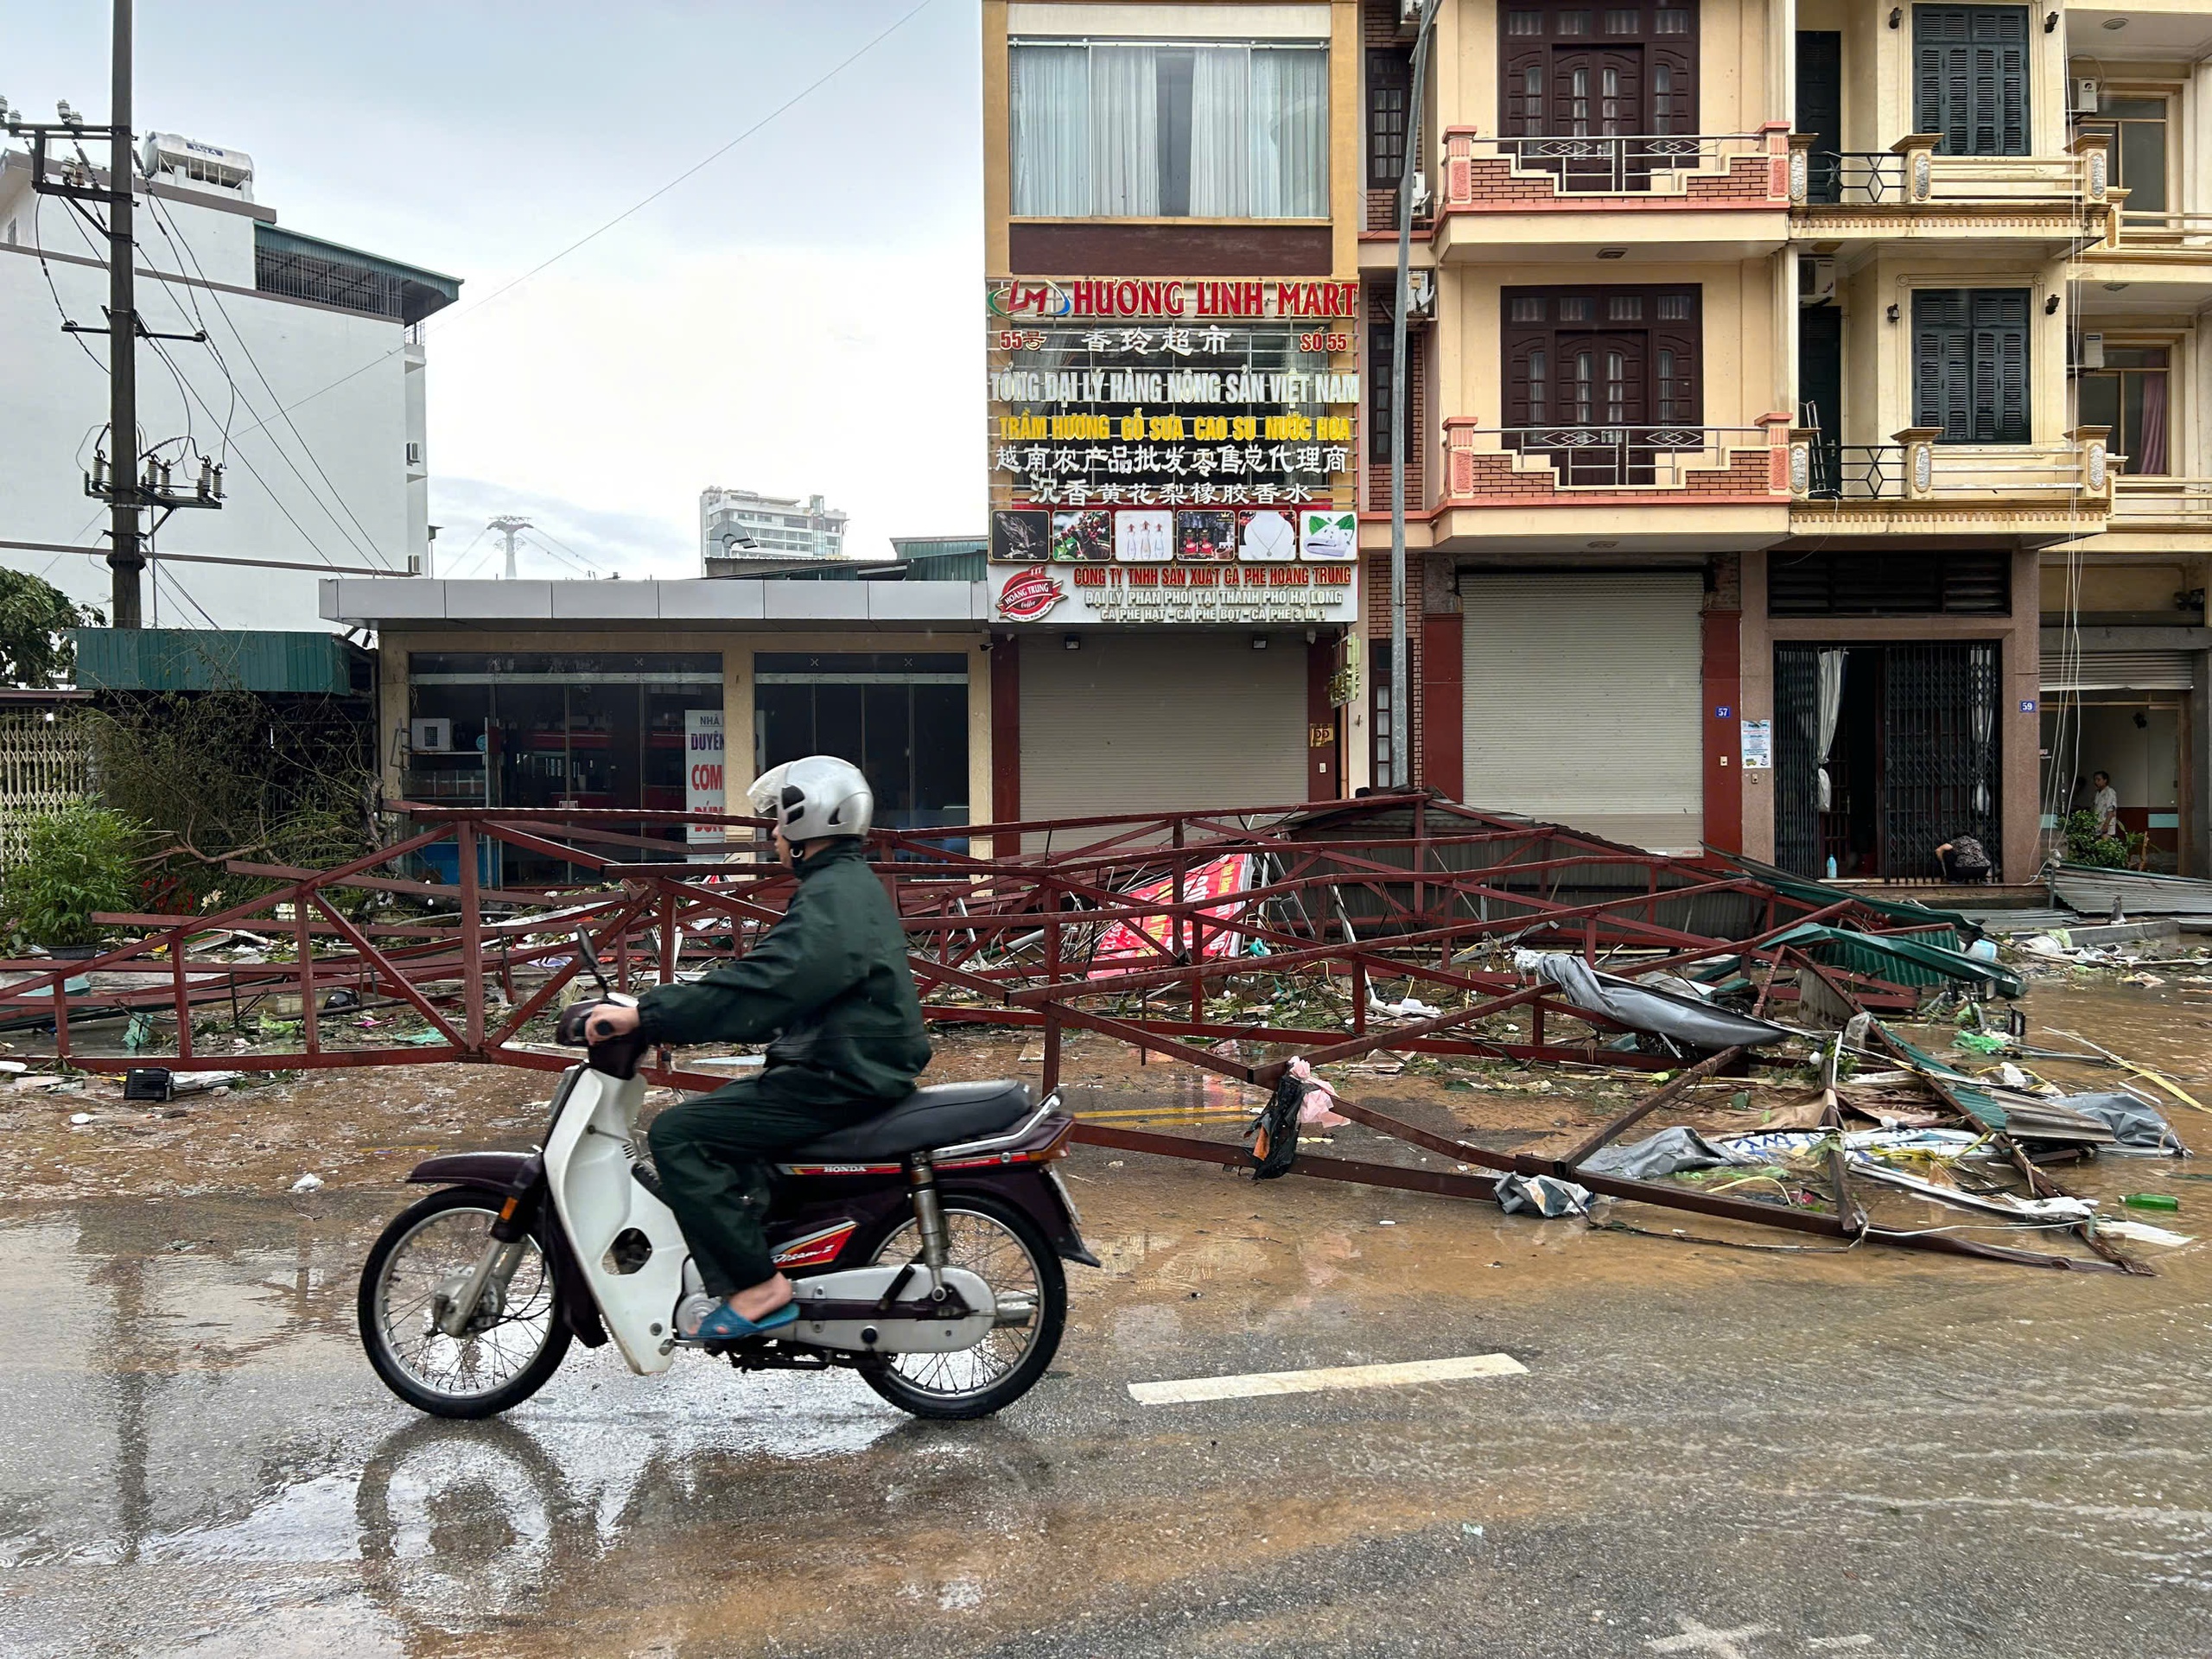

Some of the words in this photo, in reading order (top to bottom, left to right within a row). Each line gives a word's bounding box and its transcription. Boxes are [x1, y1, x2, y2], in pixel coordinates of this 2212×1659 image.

[1073, 277, 1186, 317] HƯƠNG
[1195, 281, 1266, 318] LINH
[1274, 281, 1360, 318] MART
[1081, 324, 1233, 358] 香玲超市
[1300, 326, 1324, 353] SỐ
[1325, 334, 1348, 353] 55
[989, 362, 1039, 403] TỔNG
[1044, 372, 1078, 409] ĐẠI
[1082, 368, 1106, 404] LÝ
[1109, 367, 1163, 404] HÀNG
[1166, 369, 1222, 404] NÔNG
[1224, 364, 1266, 404] SẢN
[1268, 368, 1311, 410] VIỆT
[1314, 372, 1361, 404] NAM
[1051, 412, 1111, 441] HƯƠNG
[1193, 415, 1229, 442] CAO
[1232, 415, 1257, 442] SU
[1264, 410, 1313, 442] NƯỚC
[1316, 415, 1351, 442] HOA
[1029, 470, 1313, 507] 沉香黄花梨橡胶香水
[1074, 563, 1106, 587] CÔNG
[1108, 567, 1123, 587] TY
[1127, 567, 1159, 587] TNHH
[1161, 561, 1187, 587] SẢN
[1189, 561, 1221, 587] XUẤT
[1268, 563, 1310, 587] HOÀNG
[1312, 564, 1352, 587] TRUNG
[1026, 582, 1050, 597] TRUNG
[1289, 590, 1308, 608] HẠ
[1310, 590, 1344, 607] LONG
[1294, 608, 1302, 621] 3
[1304, 607, 1318, 621] IN
[1319, 608, 1326, 621] 1
[1718, 708, 1728, 717] 57
[2022, 702, 2033, 711] 59
[700, 714, 720, 726] NHÀ
[692, 764, 722, 791] CƠM
[771, 1253, 822, 1264] Dream
